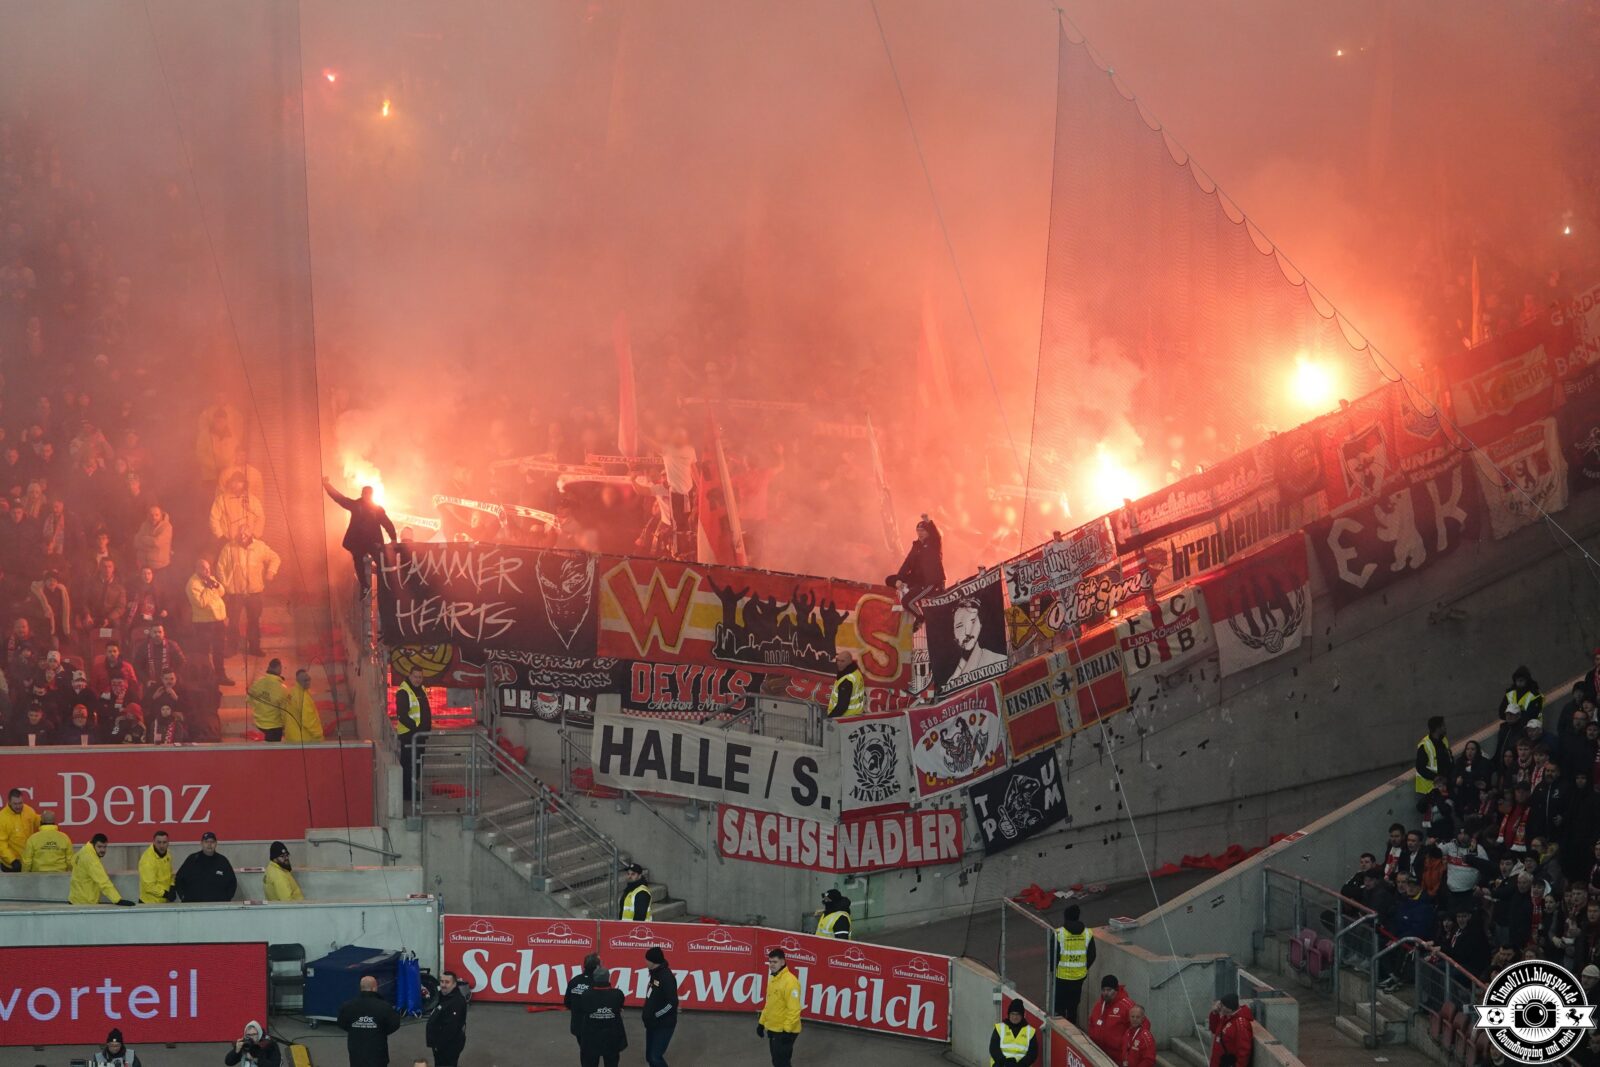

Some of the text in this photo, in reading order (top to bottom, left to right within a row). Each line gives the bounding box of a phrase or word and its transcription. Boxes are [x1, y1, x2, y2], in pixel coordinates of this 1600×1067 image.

[379, 549, 524, 594] HAMMER
[395, 595, 517, 643] HEARTS
[1075, 648, 1122, 685] BERLIN
[630, 661, 752, 711] DEVILS
[1005, 681, 1052, 717] EISERN
[848, 723, 902, 743] SIXTY
[600, 724, 752, 795] HALLE
[848, 780, 901, 802] NINERS
[720, 808, 961, 870] SACHSENADLER
[451, 934, 512, 944] Schwarzwaldmilch
[529, 936, 591, 946] Schwarzwaldmilch
[611, 939, 672, 950] Schwarzwaldmilch
[689, 942, 750, 953] Schwarzwaldmilch
